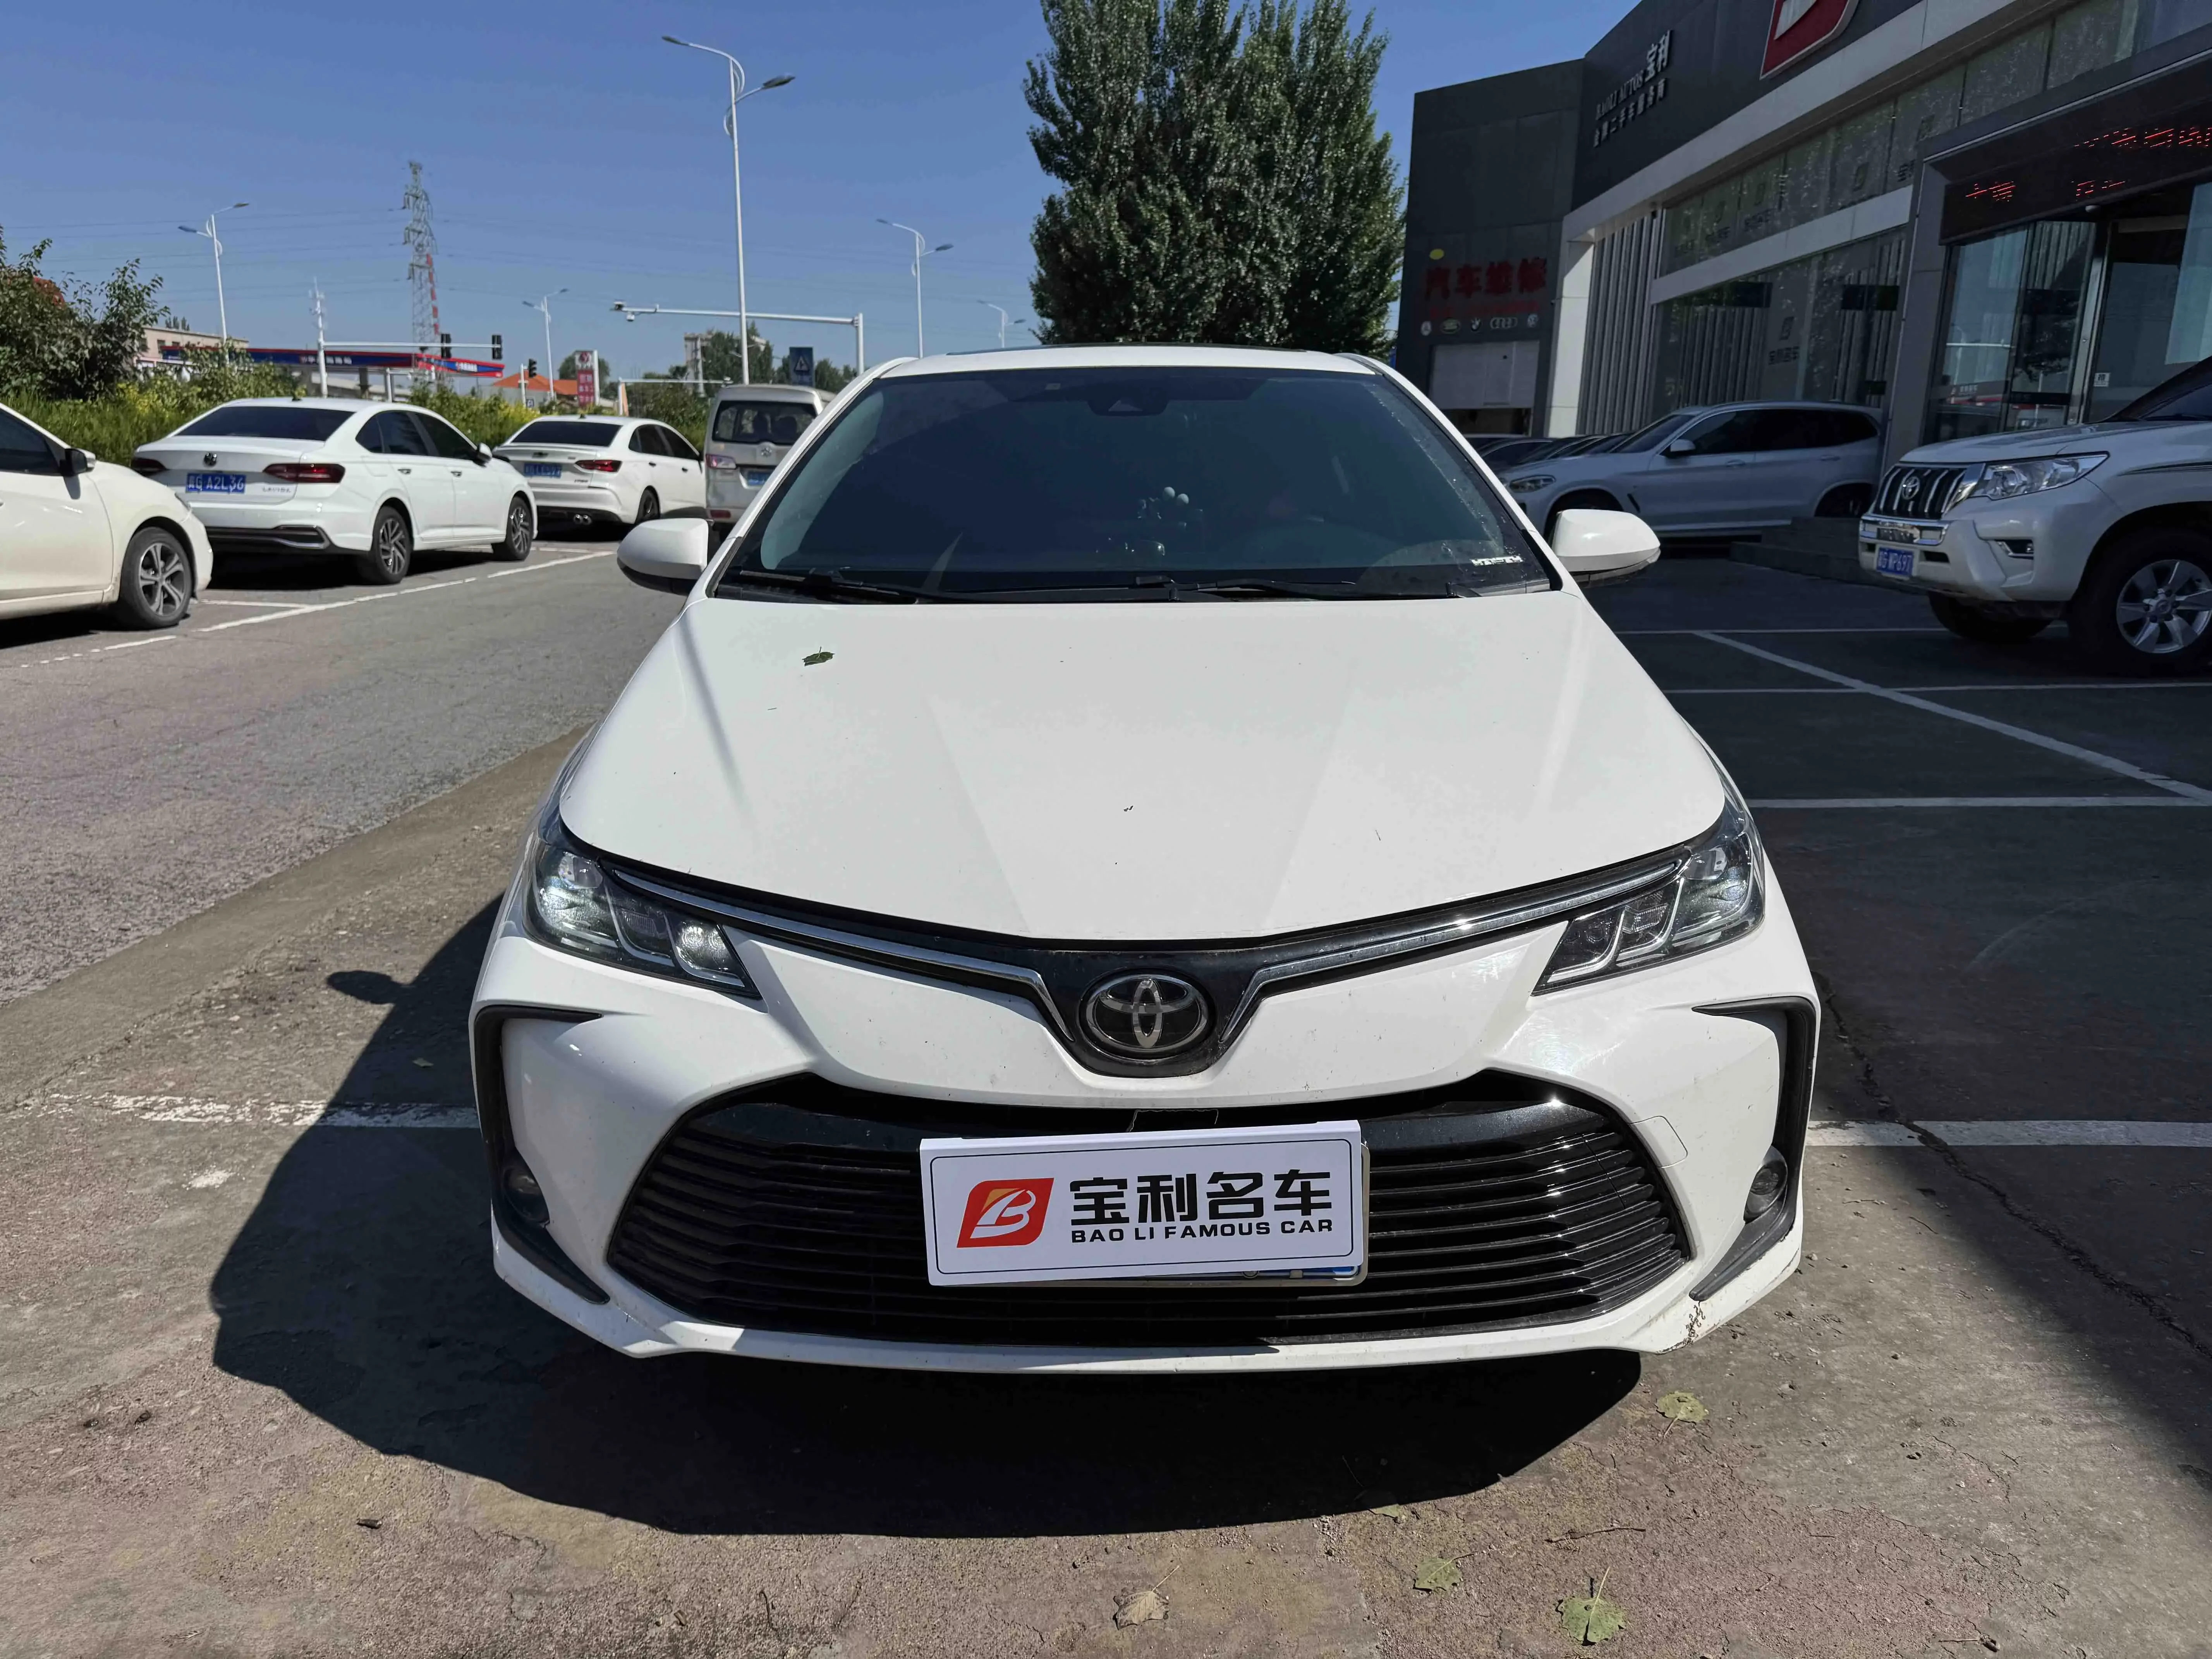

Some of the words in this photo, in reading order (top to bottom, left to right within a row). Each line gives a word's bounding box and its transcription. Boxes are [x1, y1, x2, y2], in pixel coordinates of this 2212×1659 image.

[1644, 29, 1670, 82] 宝利
[1424, 257, 1547, 301] 汽车维修
[1070, 1169, 1332, 1226] 宝利名车
[1072, 1229, 1124, 1243] BAO
[1135, 1227, 1154, 1240] LI
[1164, 1222, 1270, 1239] FAMOUS
[1281, 1219, 1332, 1234] CAR
